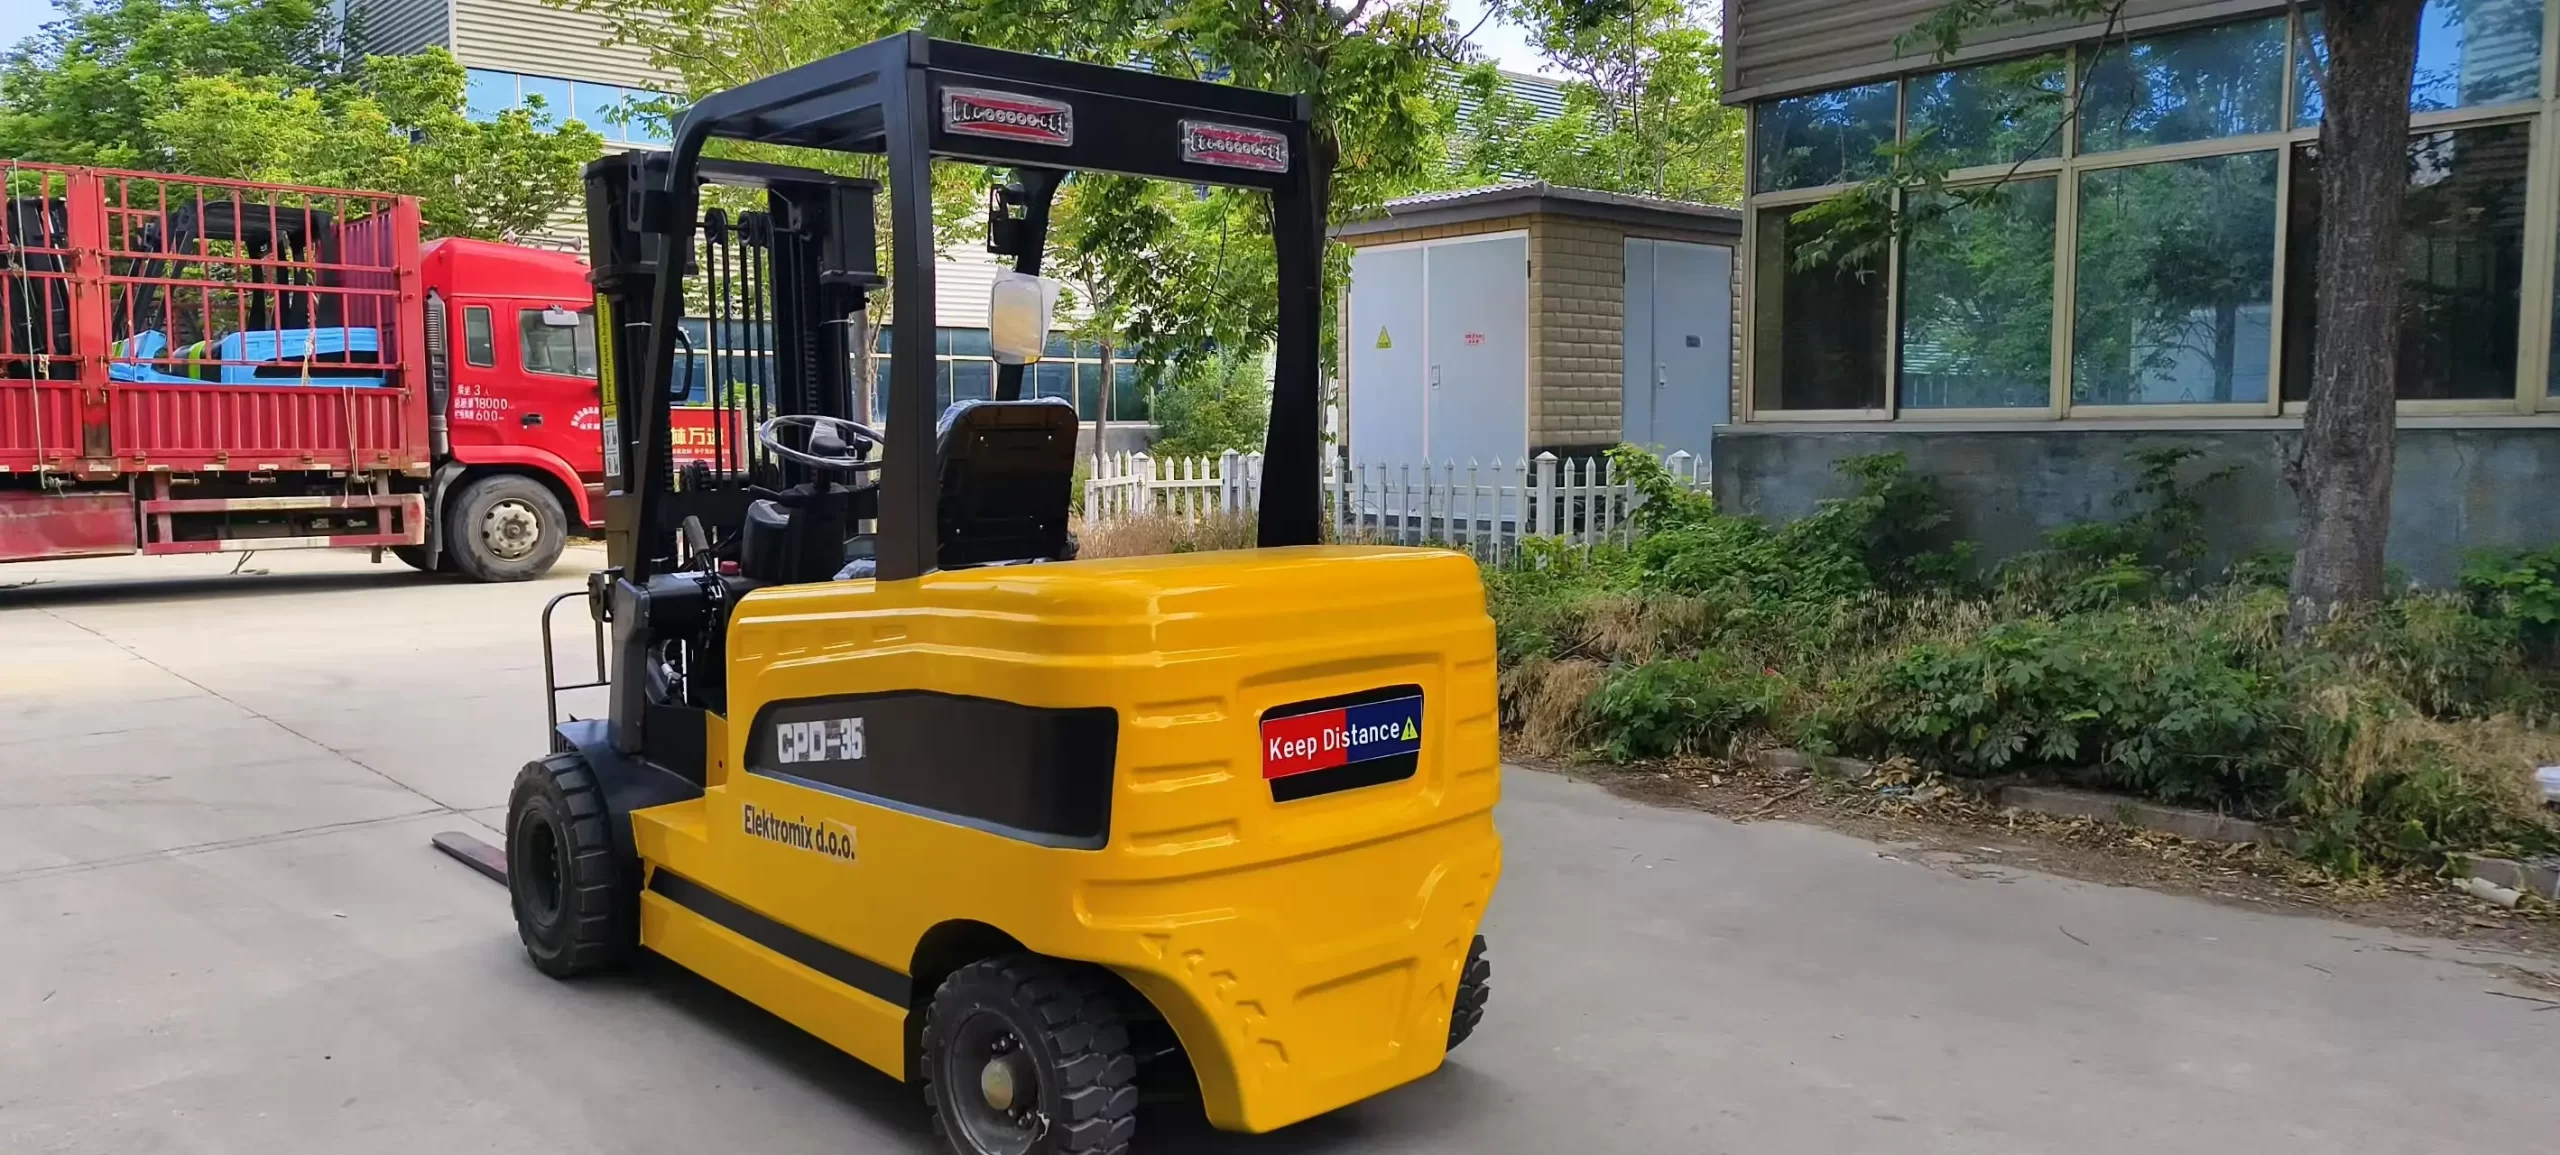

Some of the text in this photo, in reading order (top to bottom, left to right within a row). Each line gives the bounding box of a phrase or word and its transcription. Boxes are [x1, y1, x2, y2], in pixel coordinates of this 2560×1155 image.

[474, 384, 481, 397] 3
[475, 397, 509, 411] 18000
[476, 410, 499, 422] 600
[777, 717, 865, 763] CPD-35
[1269, 721, 1400, 761] Keep Distance
[744, 804, 856, 860] Elektromix d.o.o.
